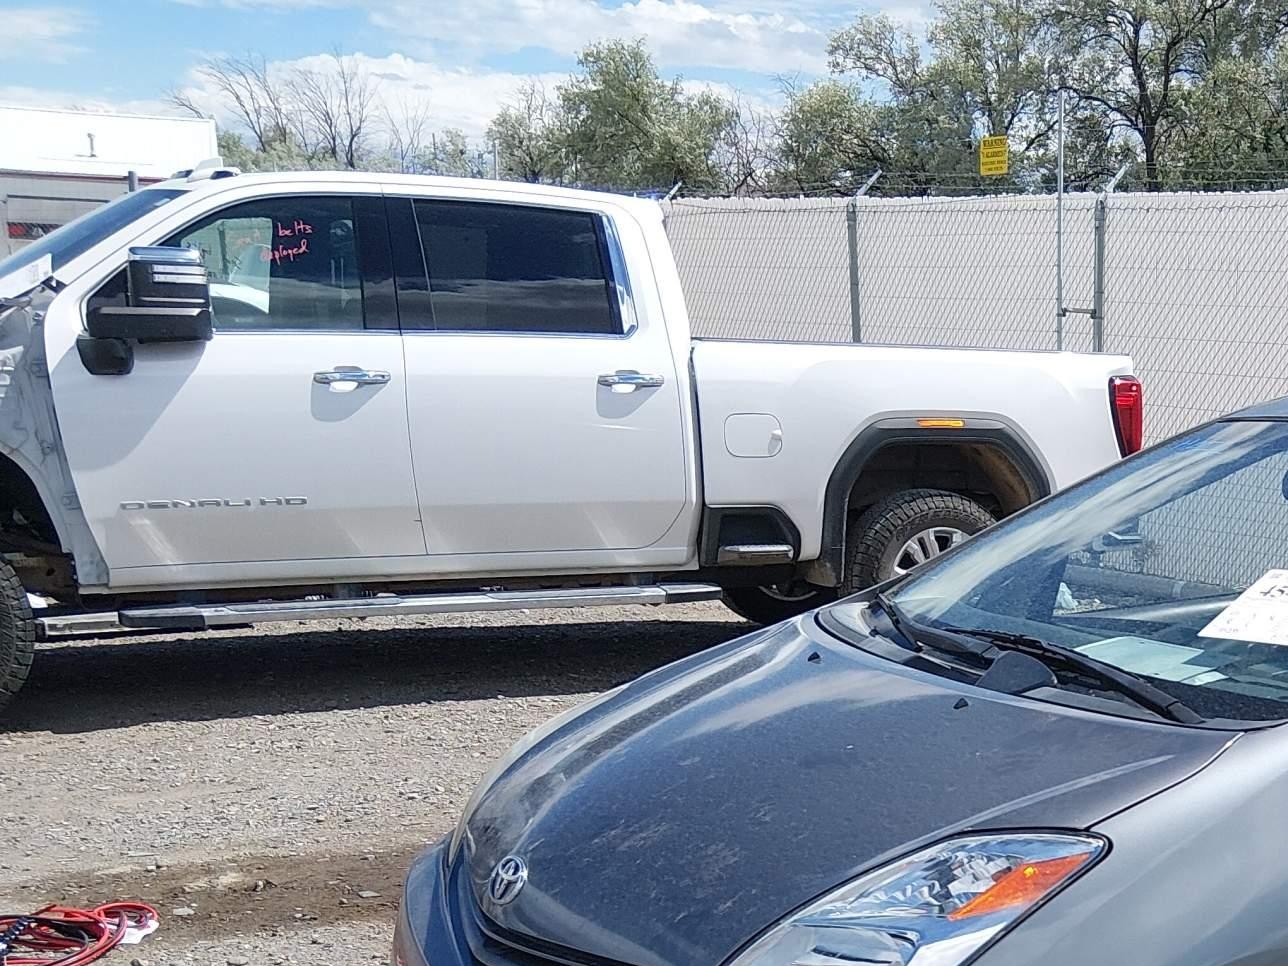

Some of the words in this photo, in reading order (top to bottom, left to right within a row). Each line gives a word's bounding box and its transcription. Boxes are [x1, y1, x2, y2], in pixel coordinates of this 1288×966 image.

[277, 220, 312, 236] belts
[260, 239, 308, 265] ployed
[120, 499, 251, 511] DENALI
[259, 496, 307, 506] HD
